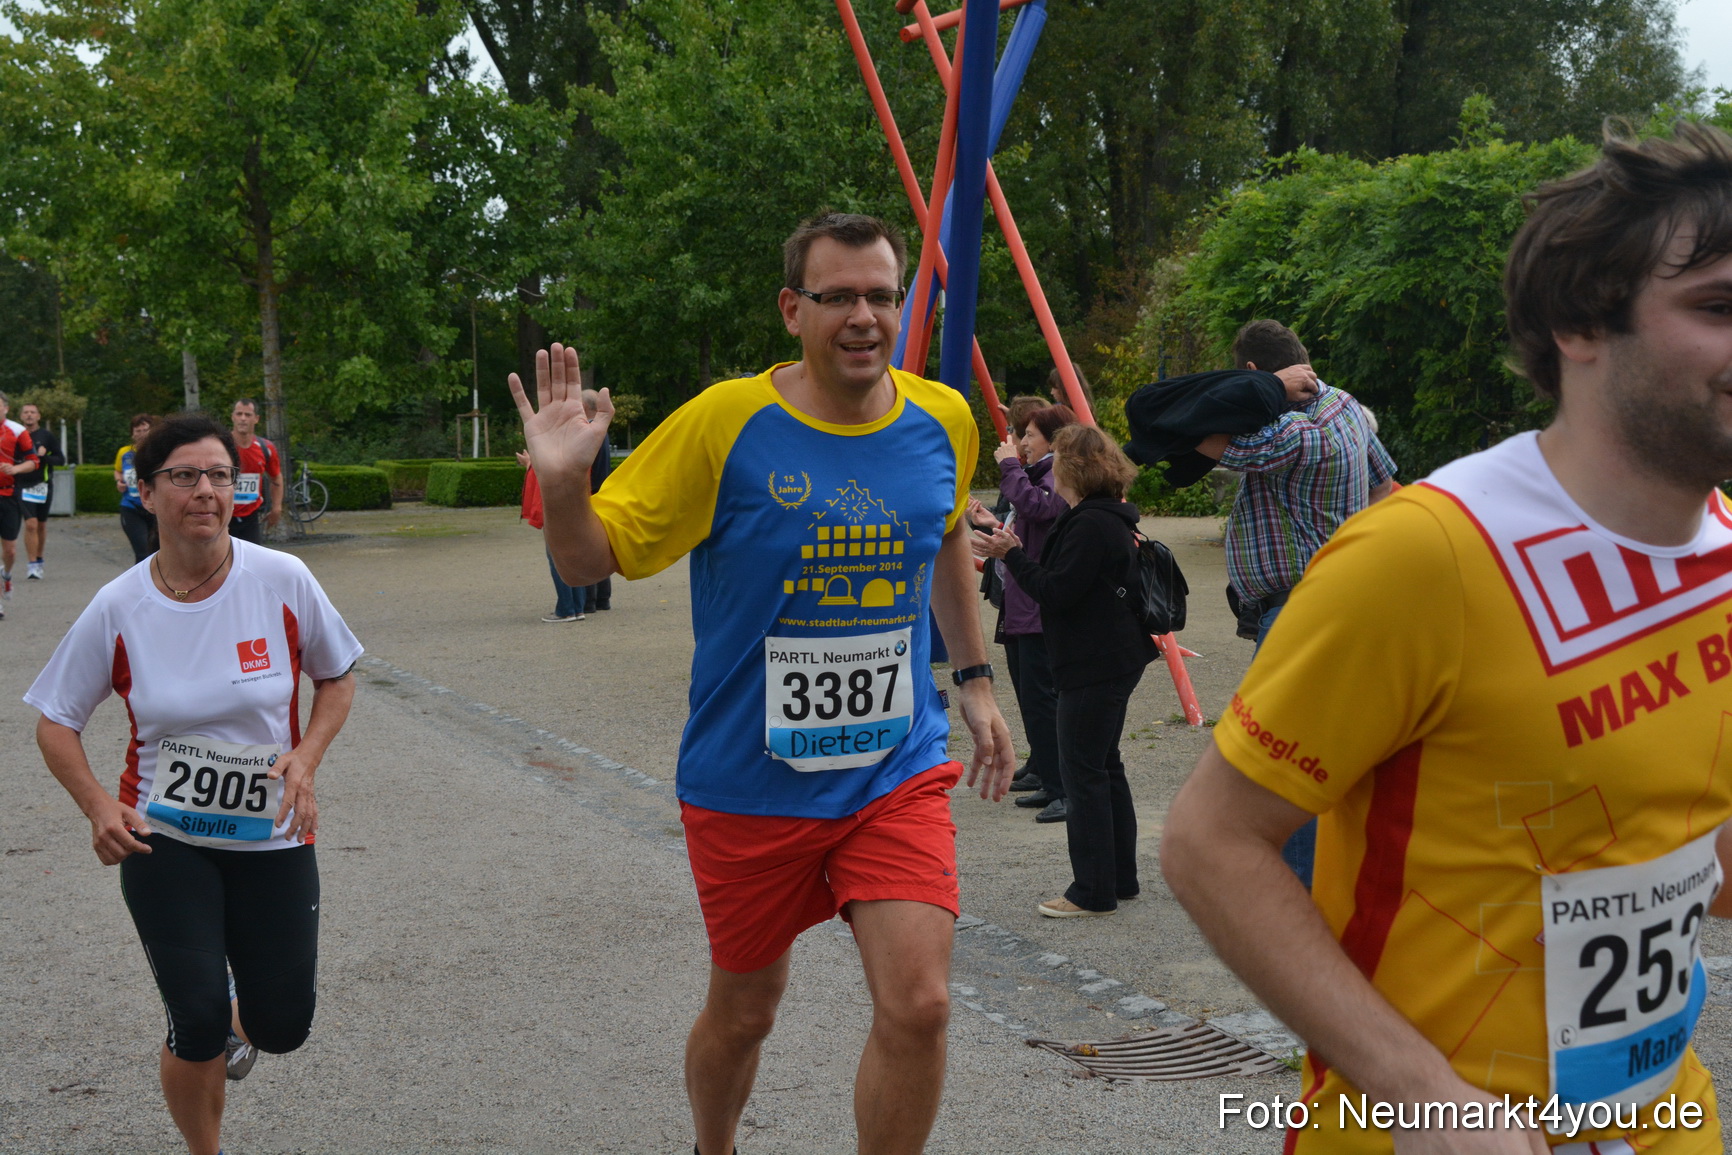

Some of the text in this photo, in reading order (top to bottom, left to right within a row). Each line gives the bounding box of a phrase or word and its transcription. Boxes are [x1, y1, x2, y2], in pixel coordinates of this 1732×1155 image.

[234, 480, 257, 492] 470
[784, 475, 795, 483] 15
[778, 486, 803, 494] Jahre
[802, 562, 903, 575] 21.September 2014
[778, 613, 916, 628] www.stadtlauf-neumarkt.de
[242, 658, 268, 671] DKMS
[769, 647, 890, 664] PARTL Neumarkt
[1556, 613, 1732, 749] MAX B
[782, 663, 899, 721] 3387
[791, 725, 891, 758] Dieter
[161, 740, 264, 766] PARTL Neumarkt
[164, 760, 268, 812] 2905
[180, 815, 237, 836] Sibylle
[1552, 892, 1644, 924] PARTL
[1579, 890, 1717, 1029] 253
[1561, 1029, 1570, 1045] C
